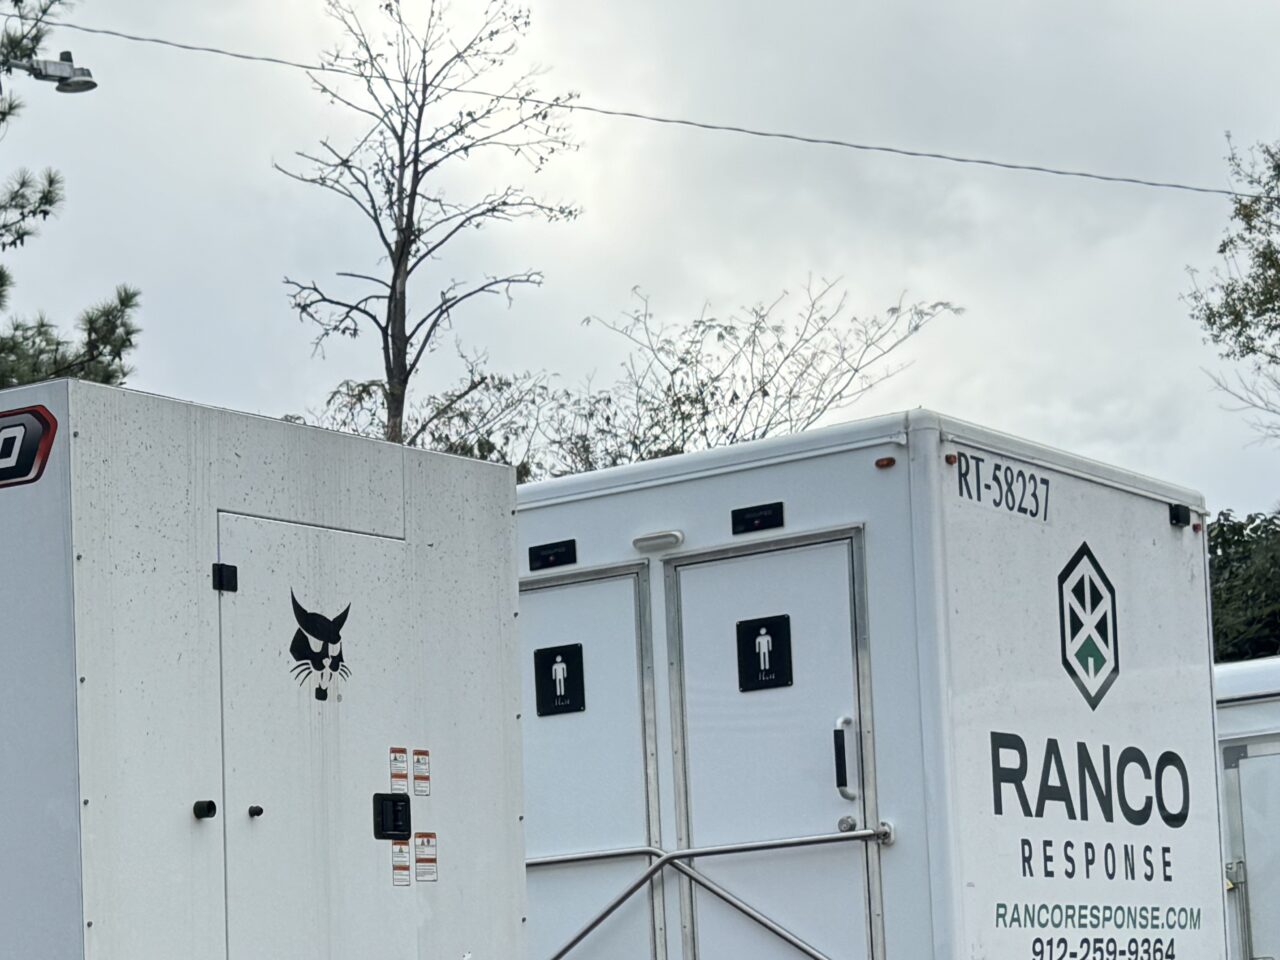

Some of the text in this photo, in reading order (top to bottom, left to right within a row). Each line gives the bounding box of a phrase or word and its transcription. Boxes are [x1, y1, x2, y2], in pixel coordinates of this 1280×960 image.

[956, 451, 1050, 522] RT-58237
[989, 731, 1190, 829] RANCO
[1020, 838, 1173, 882] RESPONSE
[995, 902, 1201, 930] RANCORESPONSE.COM
